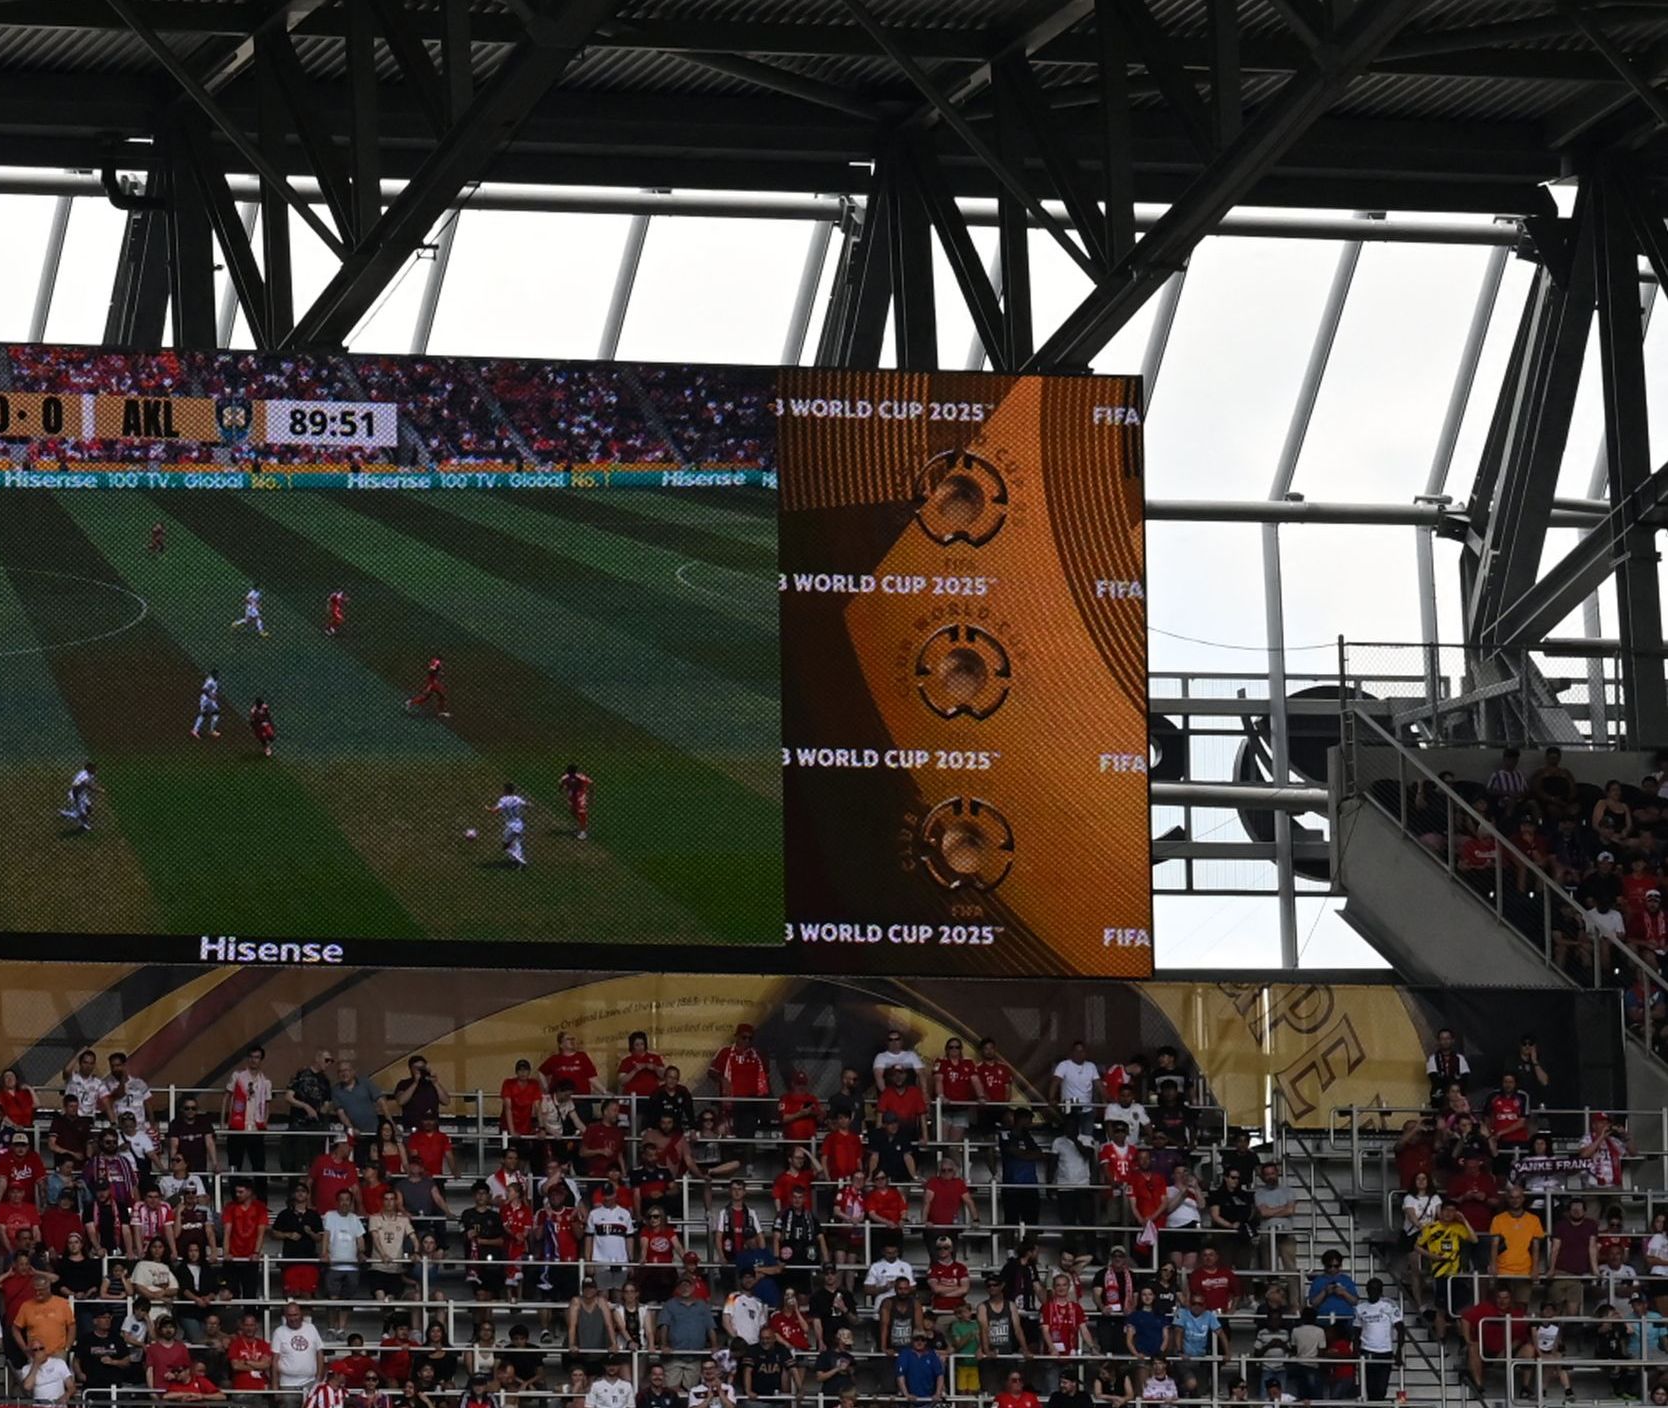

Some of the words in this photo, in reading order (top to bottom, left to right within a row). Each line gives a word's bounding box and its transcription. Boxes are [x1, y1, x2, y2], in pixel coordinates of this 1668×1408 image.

[42, 398, 63, 434] 0
[121, 401, 180, 438] AKL
[790, 400, 874, 420] WORLD
[878, 401, 923, 420] CUP
[1092, 406, 1141, 426] FIFA
[288, 410, 376, 438] 89:51
[4, 470, 98, 489] Hisense
[184, 472, 244, 489] Global
[347, 472, 431, 490] Hisense
[509, 473, 566, 490] Global
[662, 470, 747, 487] Hisense
[793, 574, 876, 593] WORLD
[881, 575, 926, 594] CUP
[1096, 580, 1144, 599] FIFA
[797, 749, 880, 768] WORLD
[885, 750, 929, 768] CUP
[1099, 754, 1146, 773] FIFA
[800, 924, 884, 943] WORLD
[888, 925, 933, 943] CUP
[1103, 927, 1150, 947] FIFA
[198, 935, 343, 964] Hisense
